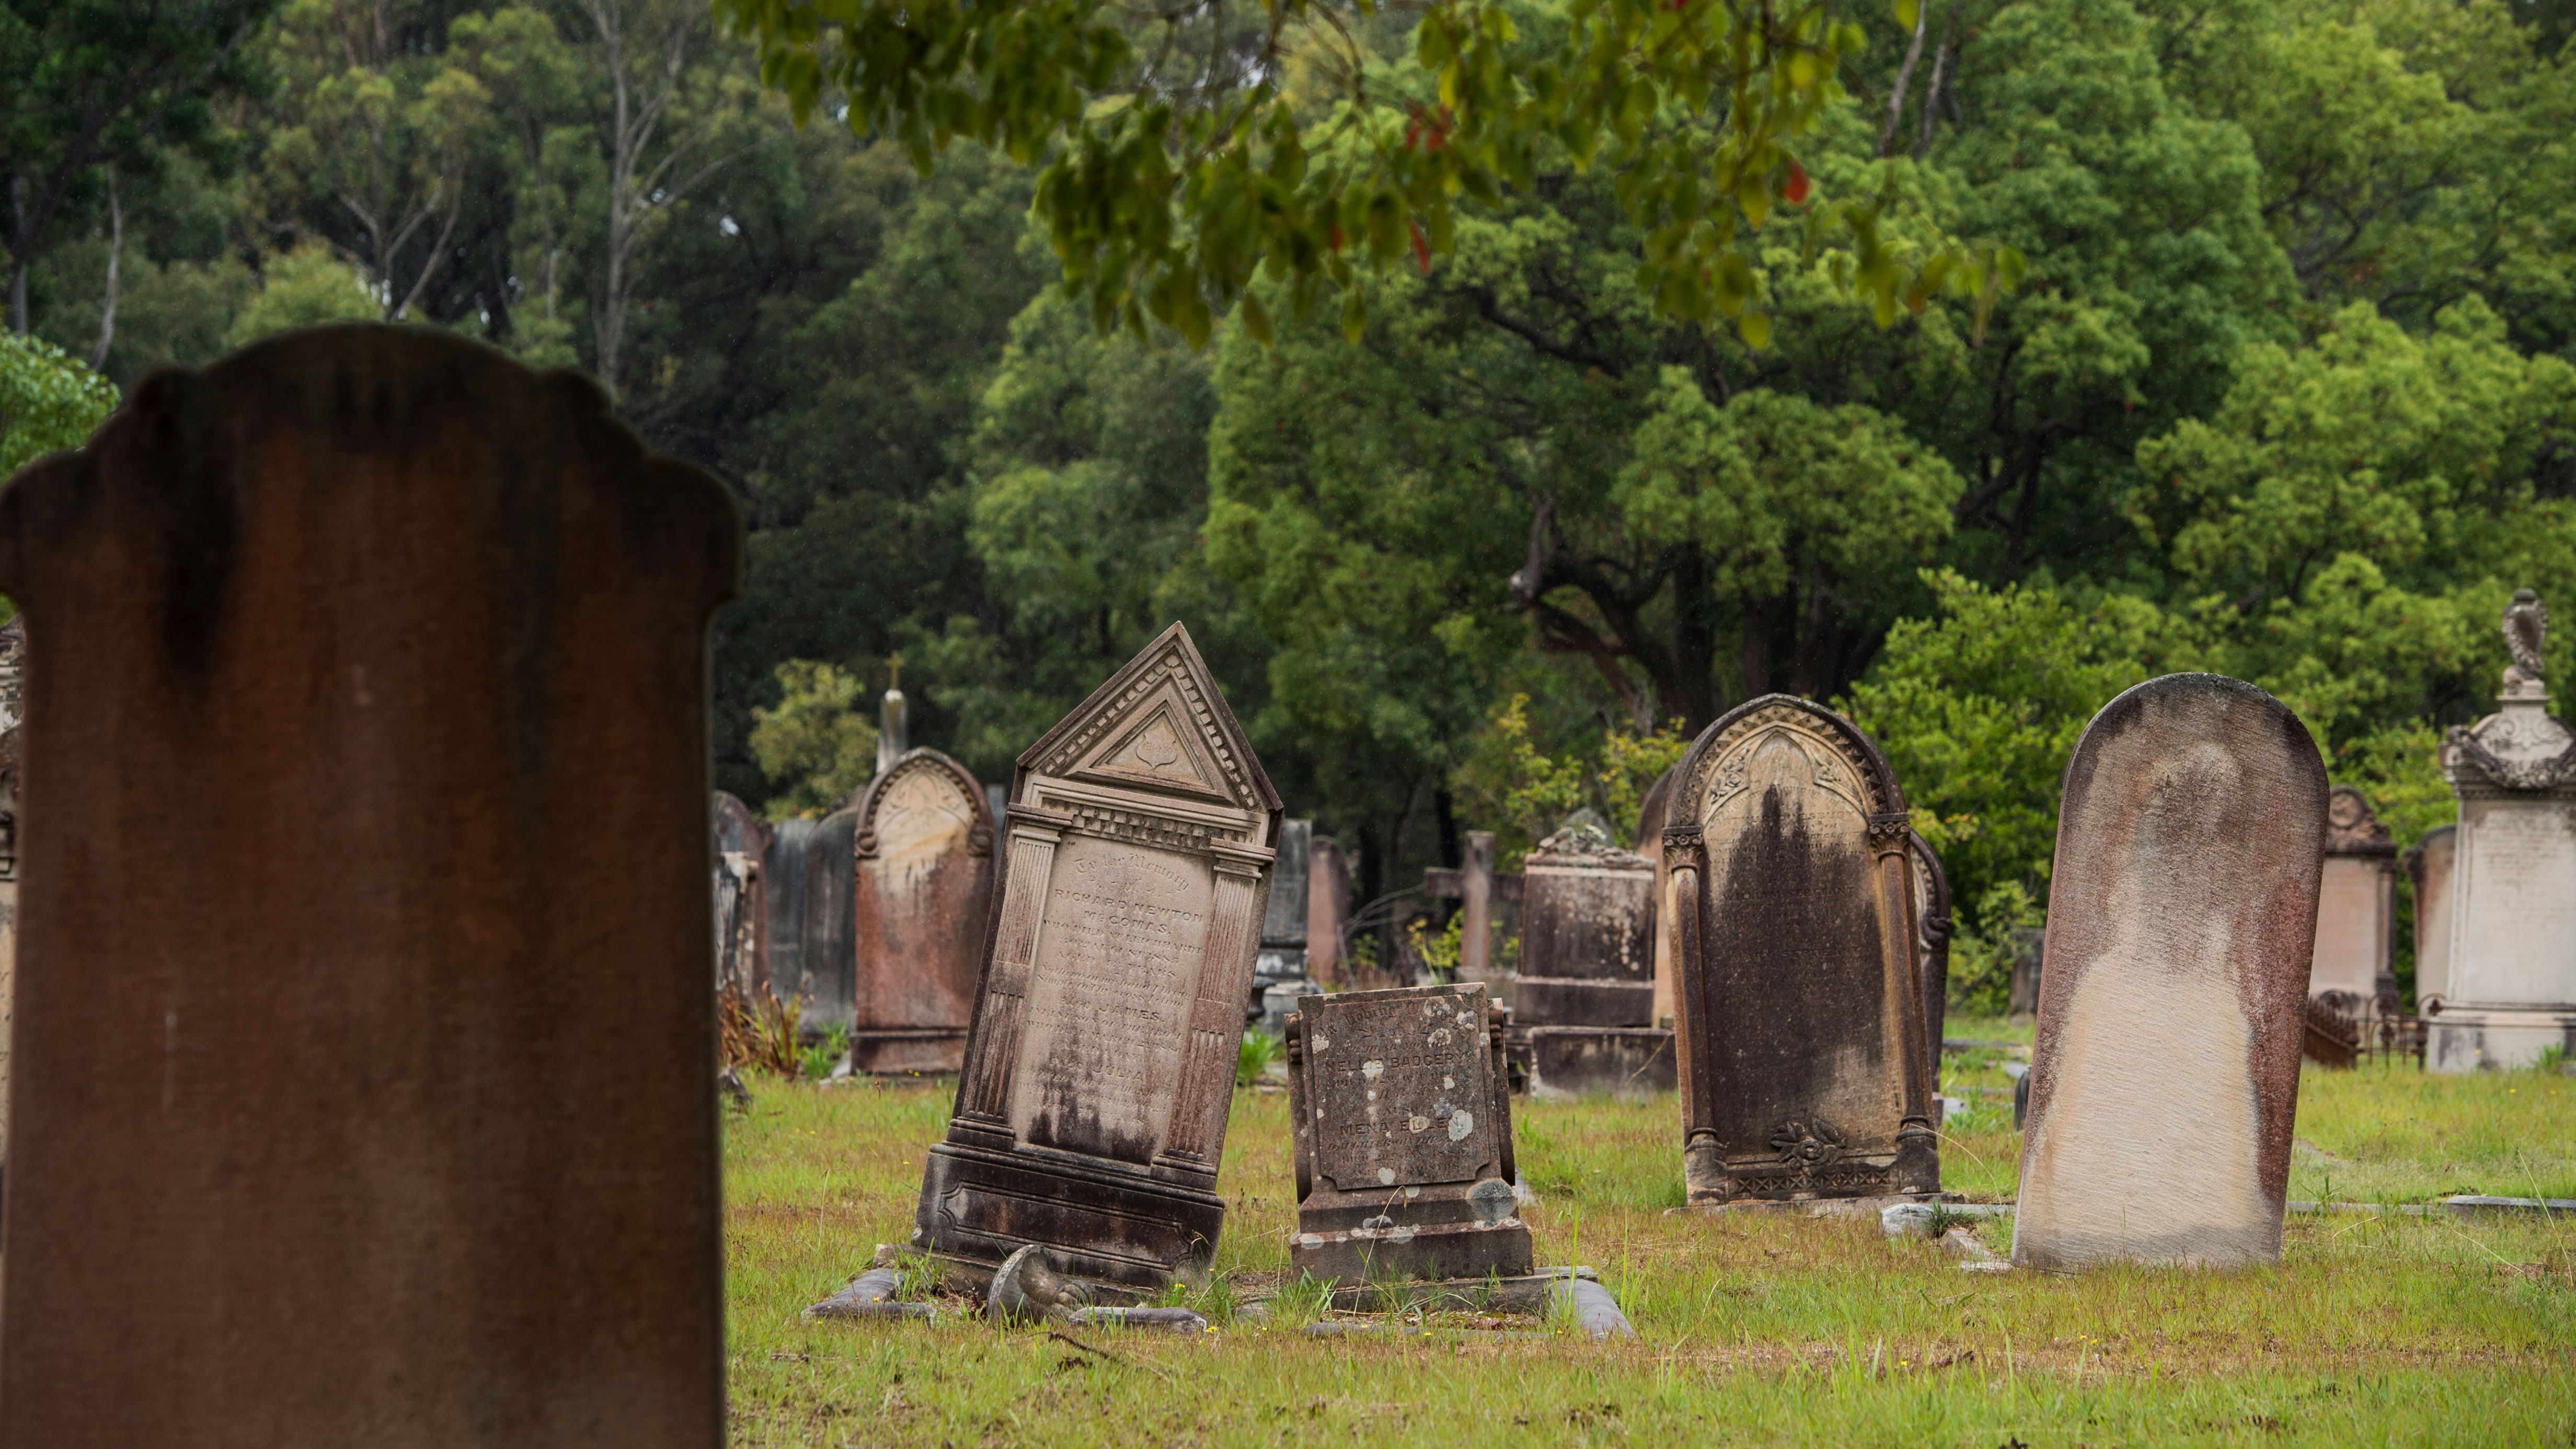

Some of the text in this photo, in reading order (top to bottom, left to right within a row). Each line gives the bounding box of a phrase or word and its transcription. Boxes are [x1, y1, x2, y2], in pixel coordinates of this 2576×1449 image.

[1722, 890, 1781, 901] WILLIAM
[1054, 889, 1203, 923] RICHARD NEWTON
[1042, 919, 1069, 931] WHO
[1073, 925, 1105, 937] DIED
[1058, 950, 1097, 964] AGED
[1119, 979, 1150, 992] hand
[1112, 990, 1145, 1001] cross
[1074, 1014, 1098, 1025] SON
[1101, 1019, 1115, 1028] OF
[1122, 1022, 1144, 1033] THE
[1343, 1006, 1397, 1026] Loving
[1026, 1019, 1052, 1031] WHO
[1055, 1025, 1087, 1037] DIED
[1325, 1052, 1466, 1073] NELLIE BADGERY
[1339, 1121, 1389, 1135] MENA
